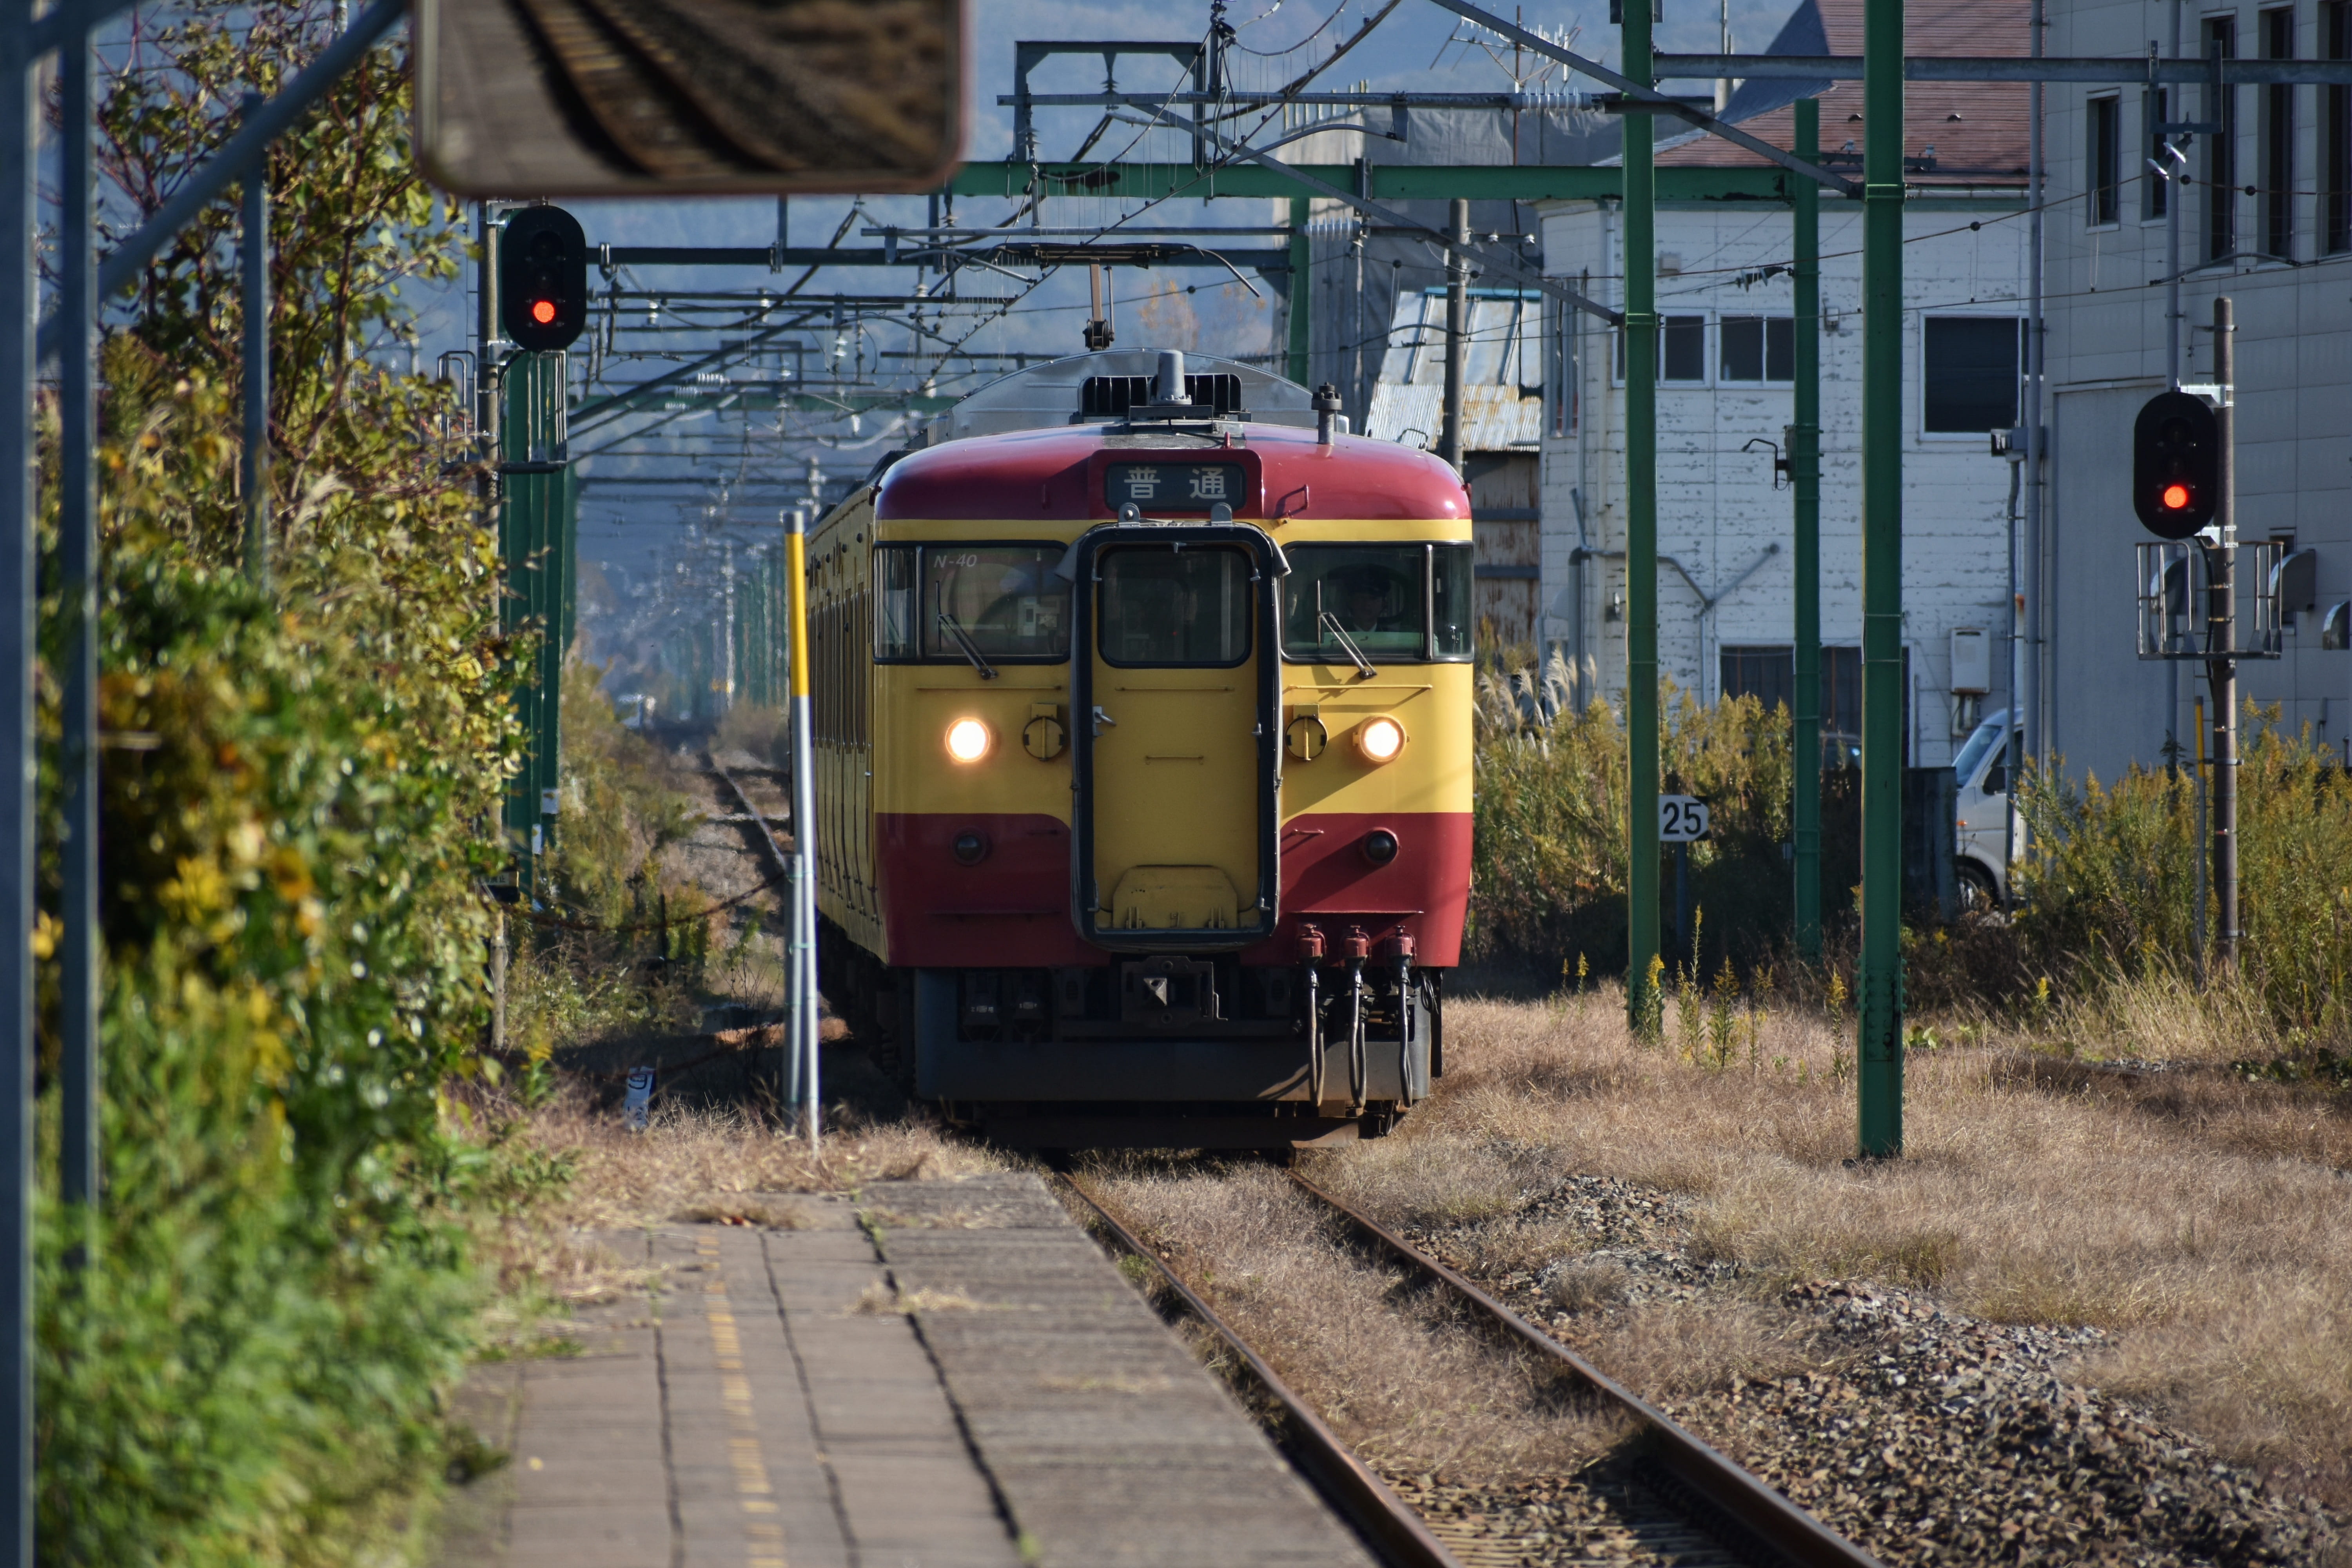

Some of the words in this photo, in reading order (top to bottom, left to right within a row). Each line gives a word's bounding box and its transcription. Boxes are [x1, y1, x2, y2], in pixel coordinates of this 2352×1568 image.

[1124, 466, 1227, 499] 普通
[934, 554, 978, 568] N-40
[1663, 801, 1701, 835] 25
